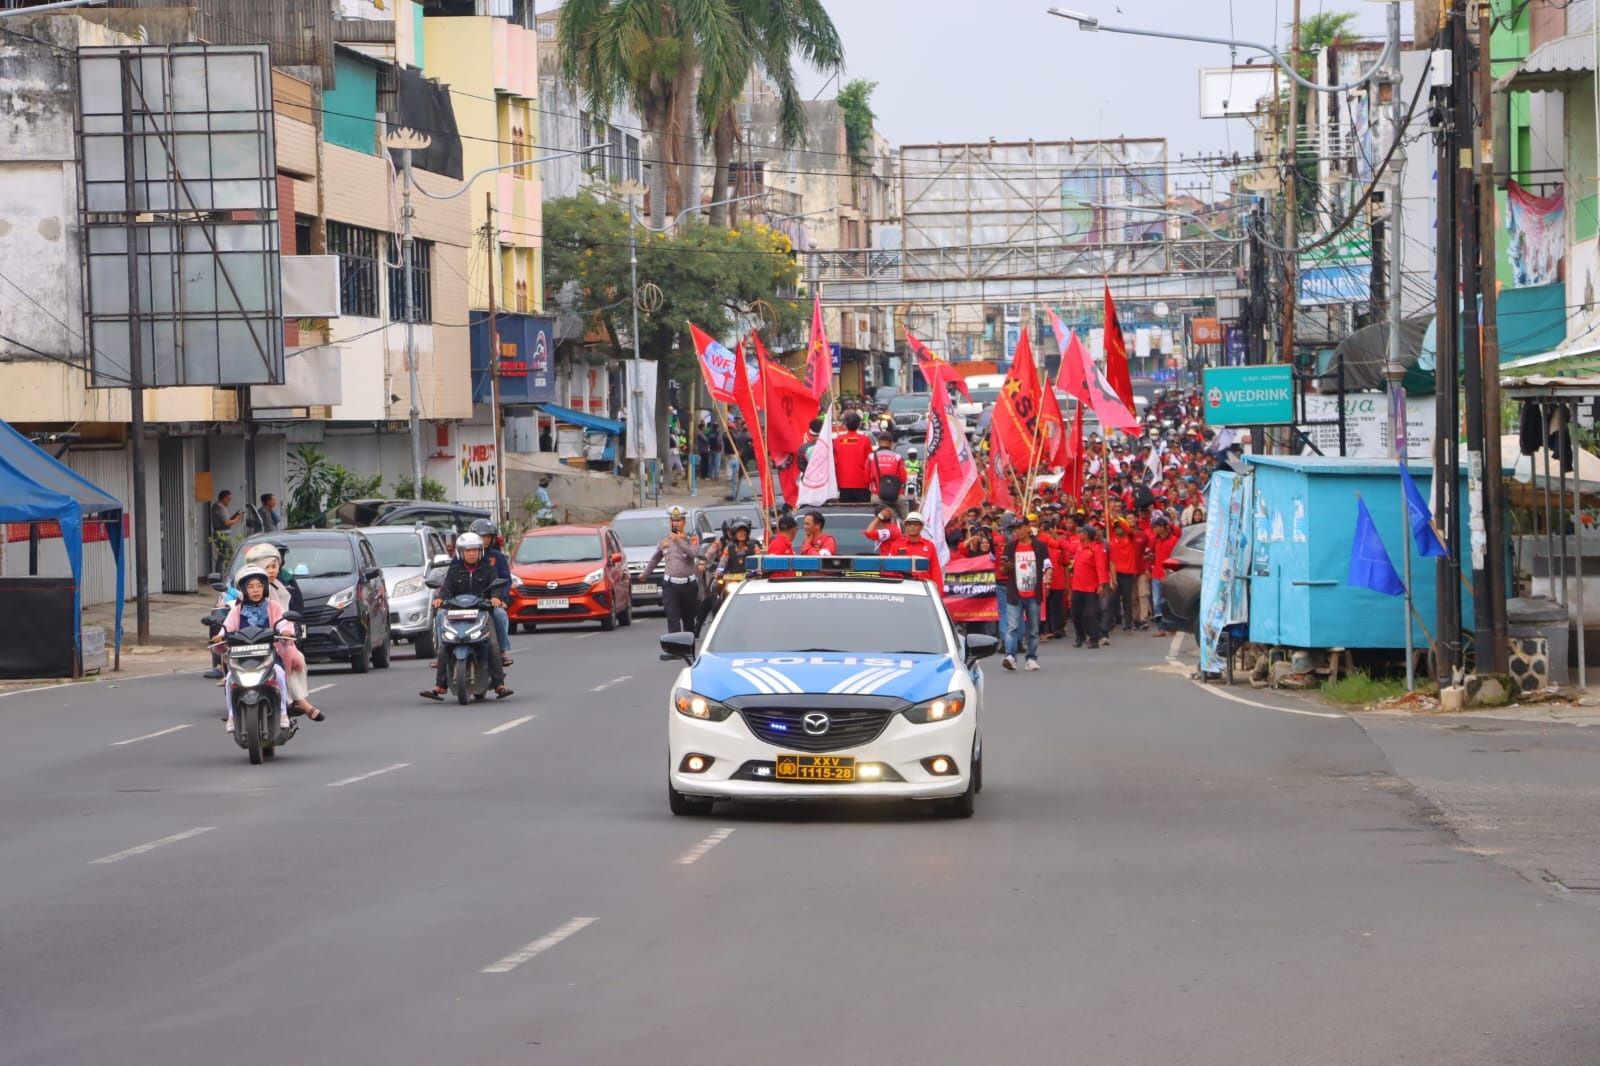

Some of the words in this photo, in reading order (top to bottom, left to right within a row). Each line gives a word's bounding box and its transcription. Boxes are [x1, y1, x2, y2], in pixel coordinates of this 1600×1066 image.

[1225, 388, 1289, 402] WEDRINK
[960, 572, 996, 582] KERJA
[760, 592, 808, 602] SATLANTAS
[810, 591, 854, 600] POLRESTA
[731, 656, 913, 669] POLISI
[813, 757, 840, 766] XXV
[801, 767, 851, 778] 1115-28
